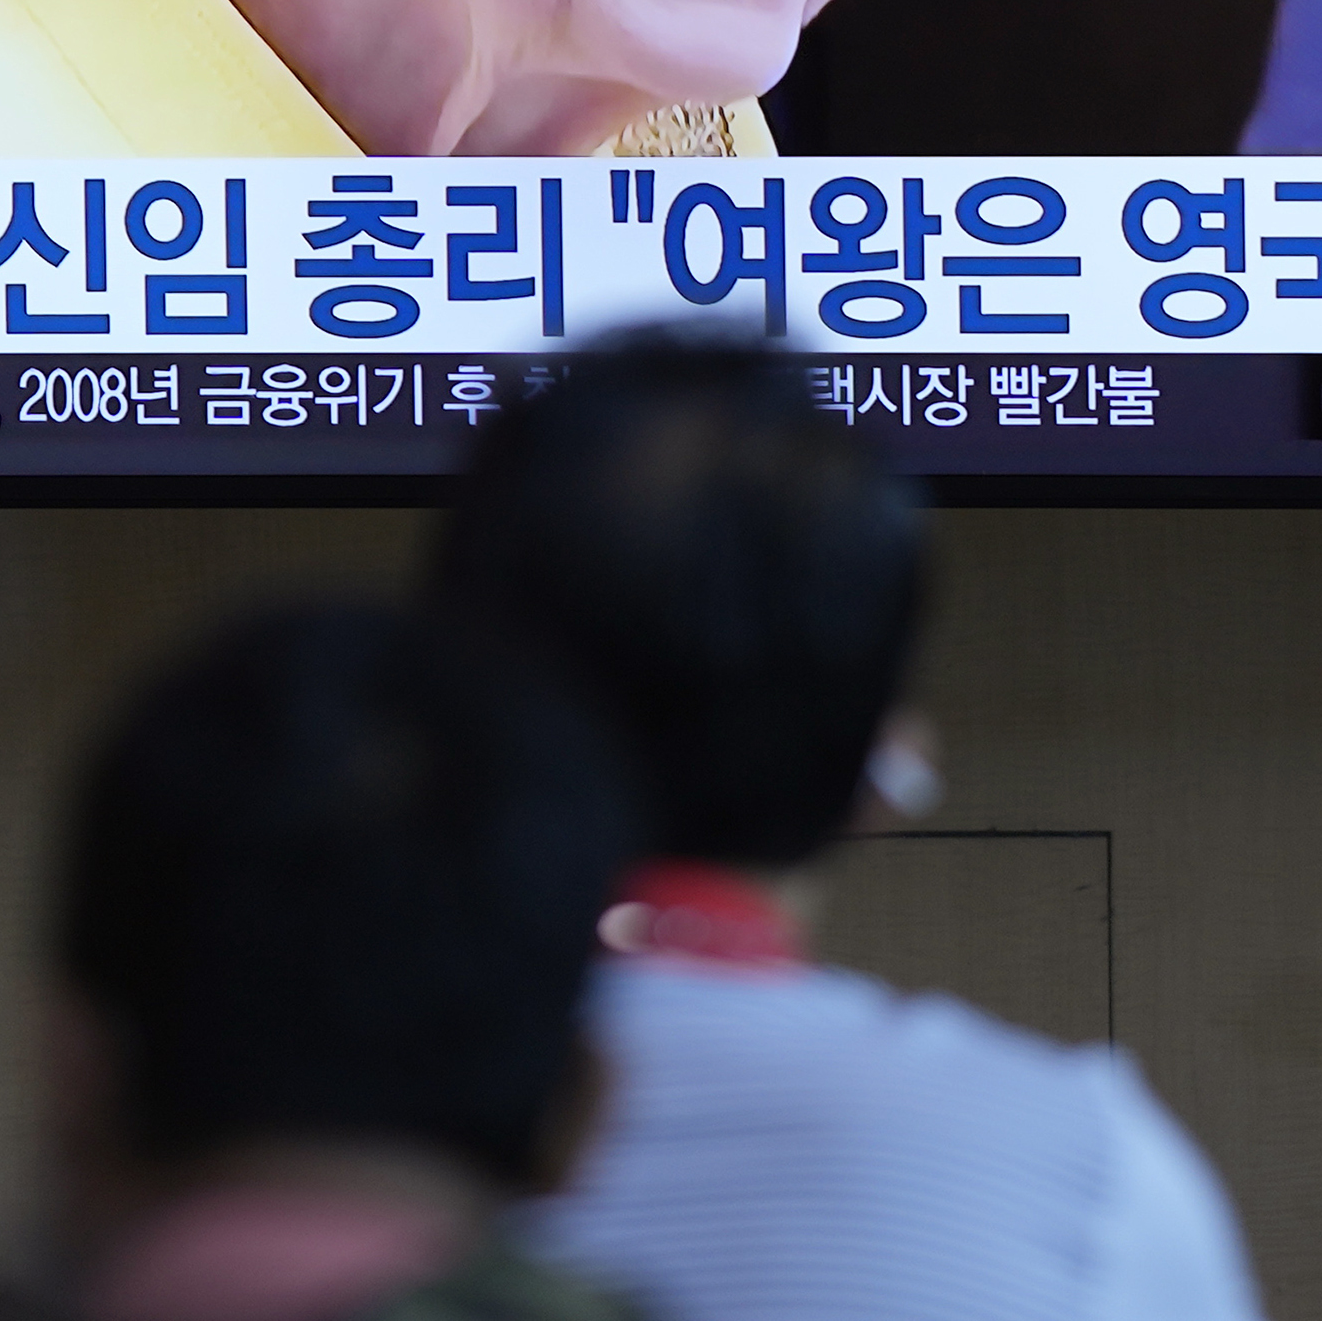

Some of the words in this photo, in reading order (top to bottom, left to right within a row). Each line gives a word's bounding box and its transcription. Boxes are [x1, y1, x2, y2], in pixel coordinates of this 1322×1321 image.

[294, 174, 565, 339] 총리
[609, 168, 1082, 340] "여왕은
[19, 365, 180, 425] 2008년
[199, 363, 423, 427] 금융위기
[443, 365, 501, 425] 후
[812, 364, 975, 427] 택시장
[990, 364, 1160, 426] 빨간불
